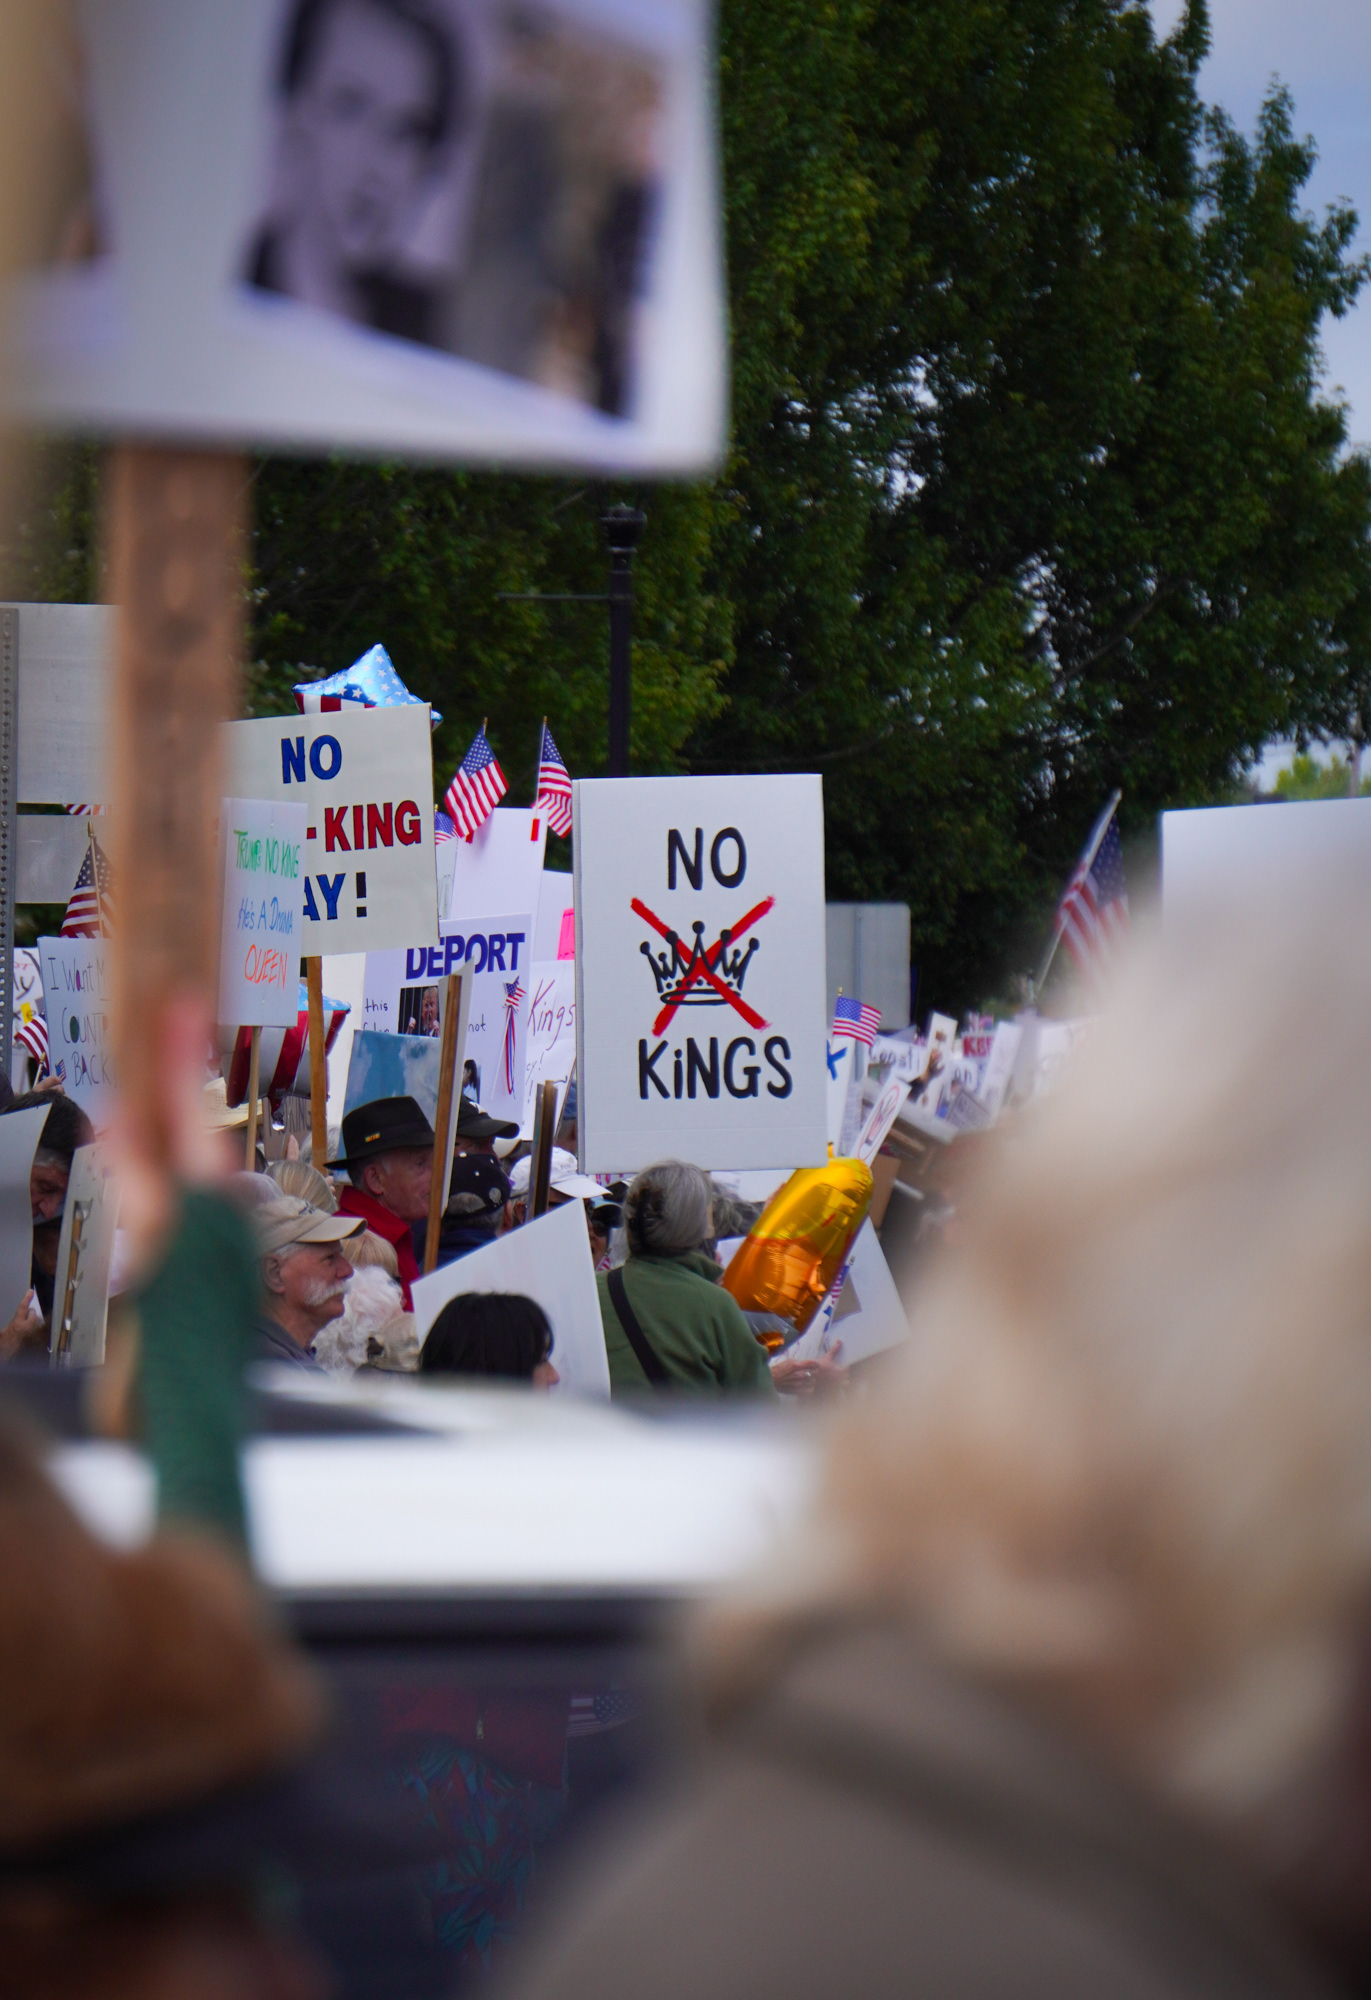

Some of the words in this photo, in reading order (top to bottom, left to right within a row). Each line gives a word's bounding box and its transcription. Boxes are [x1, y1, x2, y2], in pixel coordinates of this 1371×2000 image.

[281, 734, 342, 784] NO
[264, 837, 280, 875] NO
[668, 827, 747, 891] NO
[237, 897, 255, 931] He's
[257, 899, 267, 931] A
[303, 872, 367, 921] AY!
[47, 957, 60, 991] I
[61, 957, 95, 993] Want
[244, 943, 288, 990] QUEEN
[405, 932, 526, 980] DEPORT
[364, 997, 389, 1015] this
[467, 1013, 486, 1033] not
[526, 978, 576, 1051] Kings
[638, 1036, 793, 1100] KiNGS
